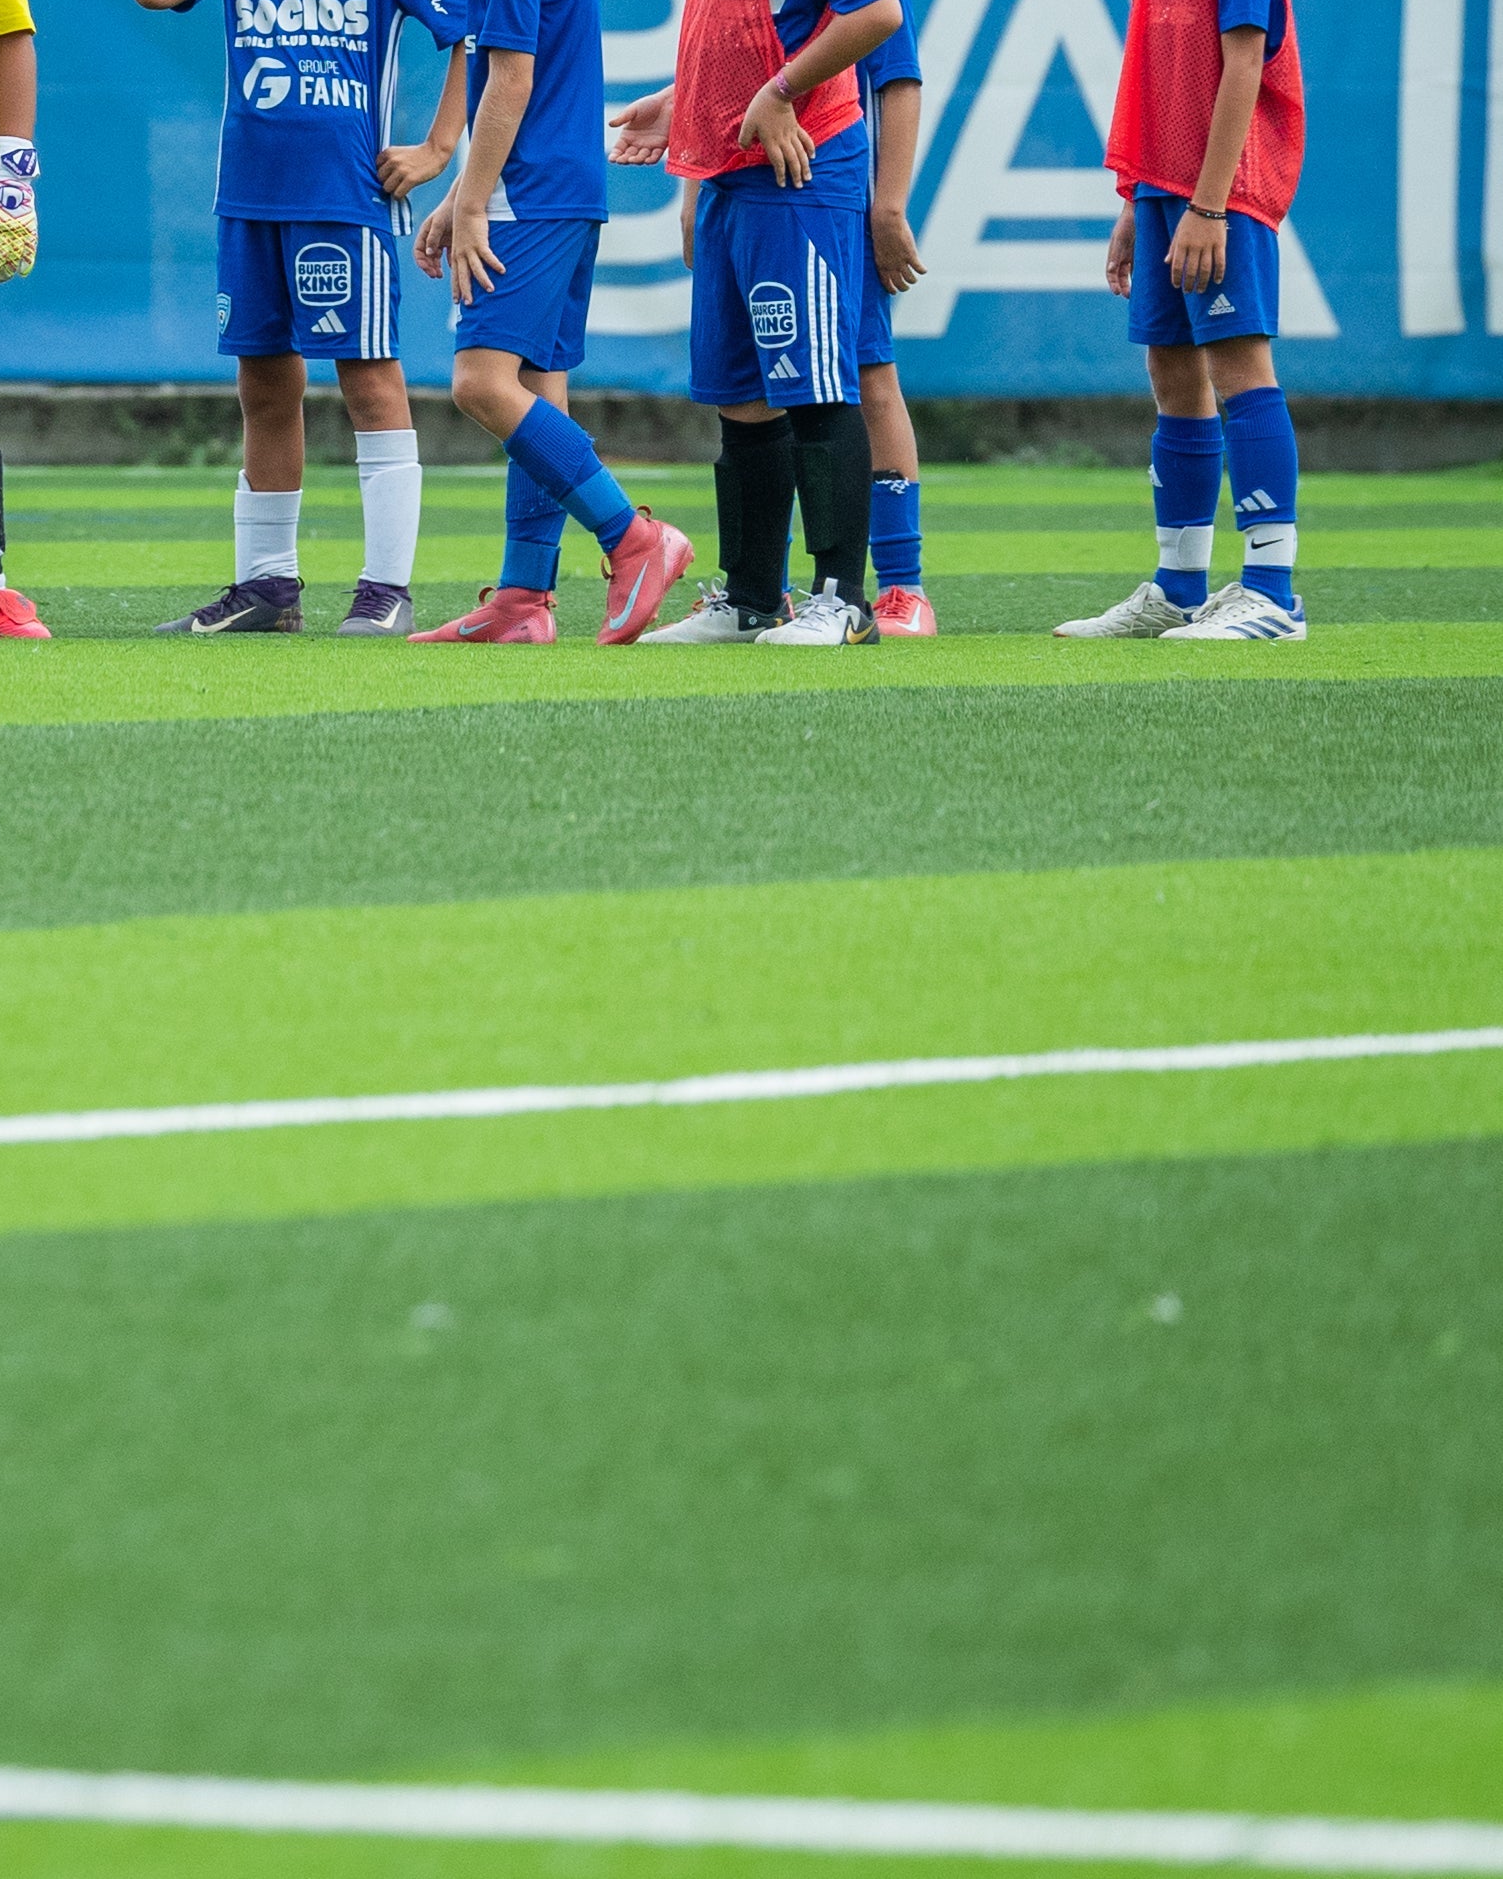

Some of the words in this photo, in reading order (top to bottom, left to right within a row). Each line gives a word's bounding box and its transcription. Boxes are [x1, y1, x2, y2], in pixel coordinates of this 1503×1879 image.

[298, 59, 340, 75] GROUPE
[299, 75, 368, 114] FANTI
[298, 263, 348, 275] BURGER
[298, 276, 348, 292] KING
[751, 303, 793, 316] BURGER
[1207, 305, 1236, 316] adidas
[755, 315, 794, 333] KING
